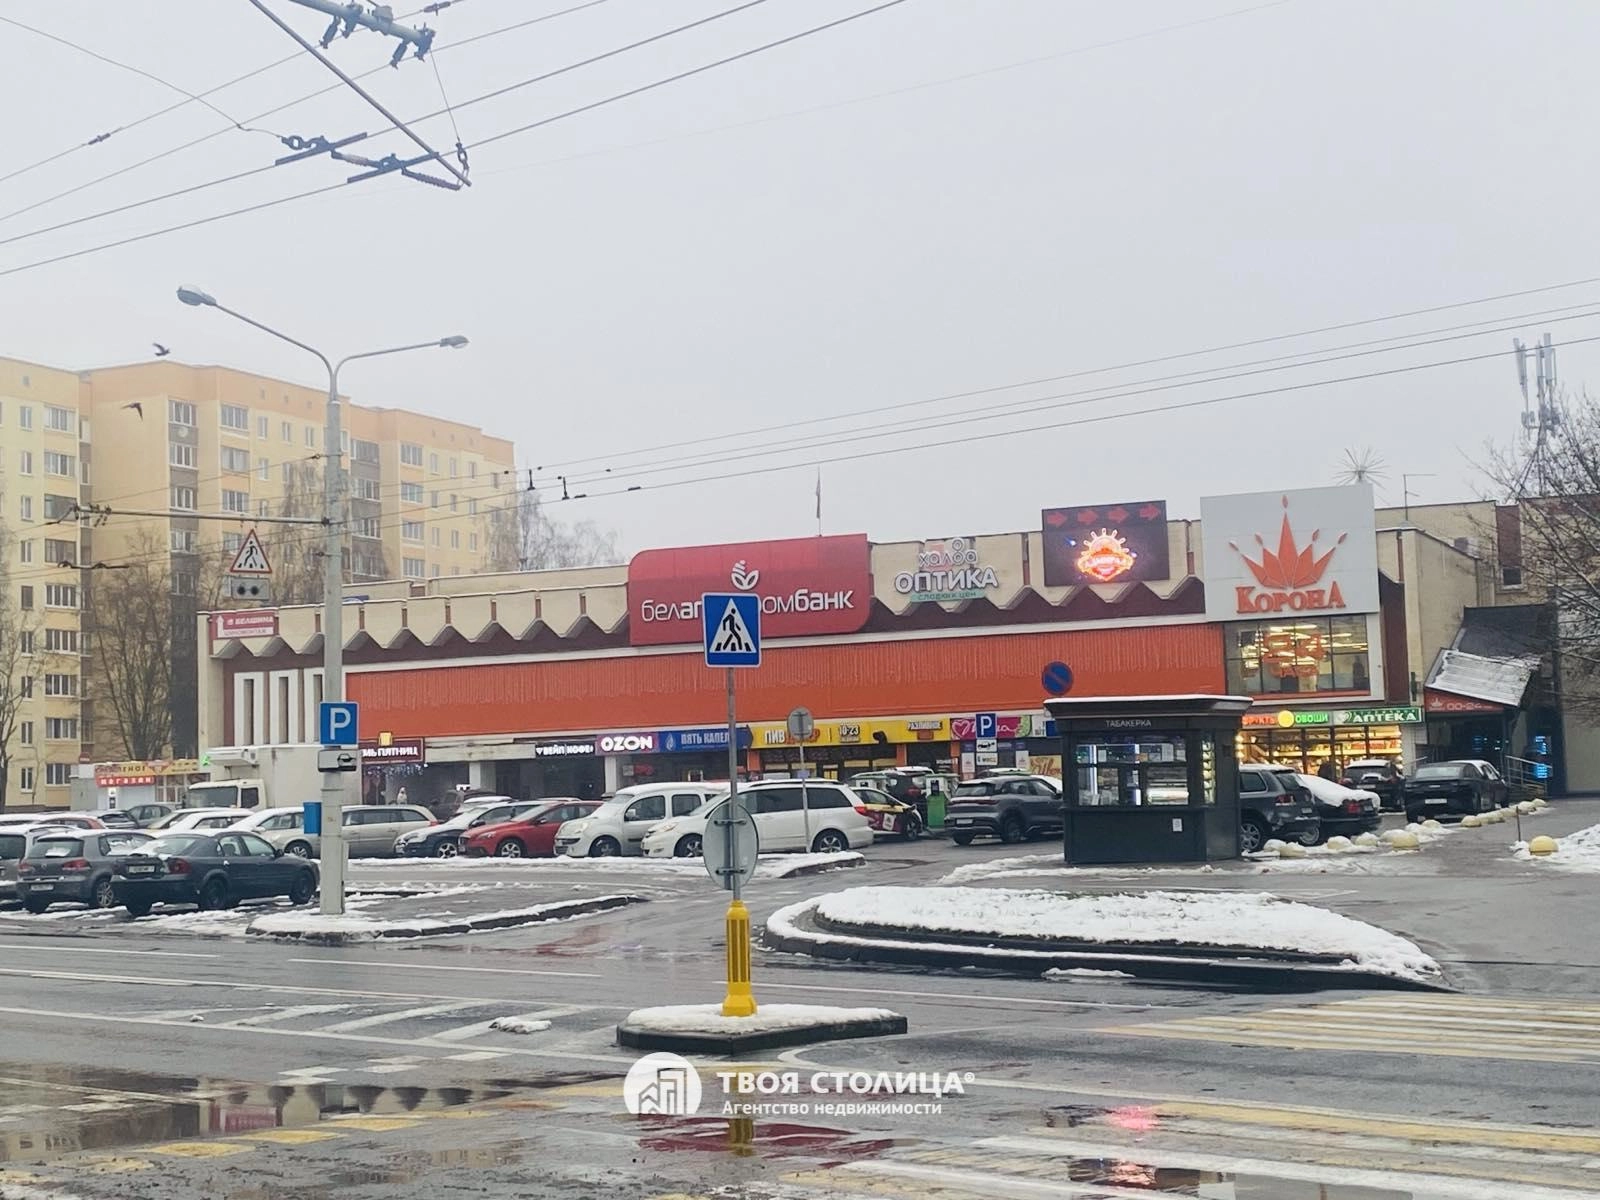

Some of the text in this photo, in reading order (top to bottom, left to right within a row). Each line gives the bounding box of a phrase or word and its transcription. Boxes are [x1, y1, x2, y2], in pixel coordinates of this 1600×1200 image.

[895, 566, 999, 594] ОПТИКА
[641, 588, 854, 623] белагомбанк
[330, 708, 351, 740] P
[981, 716, 993, 736] P
[1105, 719, 1152, 728] ТАБАКЕРКА
[1295, 711, 1329, 724] ОВОЩИ
[1353, 712, 1417, 724] АПТЕКА
[600, 735, 653, 752] OZON
[681, 731, 730, 745] ПЯТЬ КАПЕЛ
